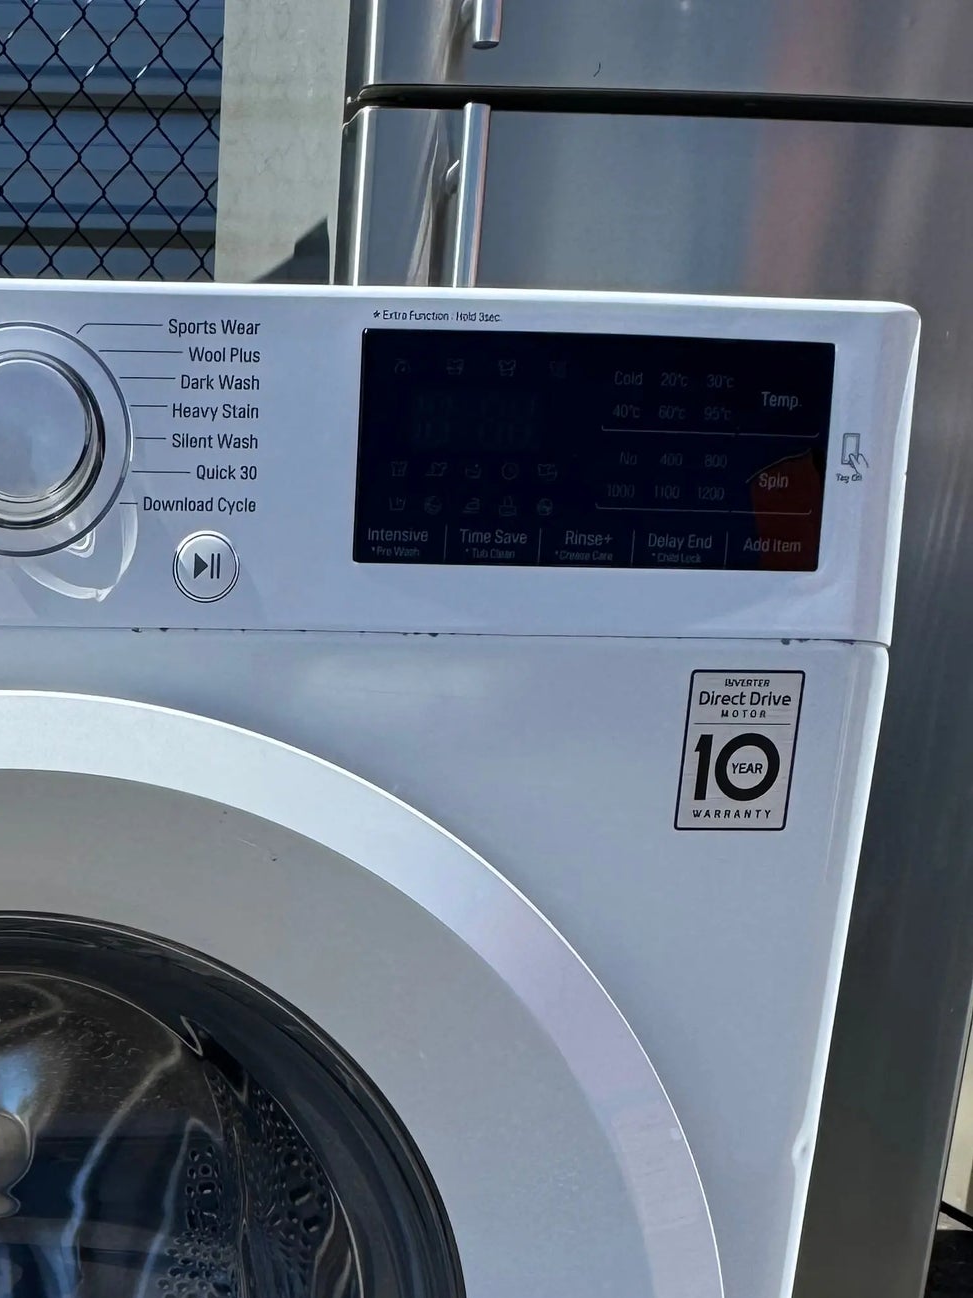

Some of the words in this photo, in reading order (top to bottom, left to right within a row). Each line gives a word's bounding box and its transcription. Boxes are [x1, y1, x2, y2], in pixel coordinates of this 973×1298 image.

[409, 310, 449, 321] Function
[456, 312, 476, 321] Hold
[168, 318, 217, 338] Sports
[221, 319, 261, 335] Wear
[189, 347, 226, 363] Wool
[230, 348, 261, 363] Plus
[181, 374, 214, 390] Dark
[219, 375, 260, 391] Wash
[614, 370, 643, 386] Cold
[761, 391, 802, 412] Temp.
[172, 403, 218, 422] Heavy
[222, 404, 259, 419] Stain
[172, 433, 213, 449] Silent
[217, 434, 258, 449] Wash
[659, 452, 683, 467] 400
[196, 464, 236, 481] Quick
[240, 465, 257, 480] 30
[758, 472, 789, 490] Spin
[606, 484, 635, 498] 1000
[654, 485, 680, 499] 1100
[698, 486, 725, 501] 1200
[143, 496, 213, 512] Download
[217, 497, 256, 516] Cycle
[367, 528, 428, 542] Intensive
[460, 529, 491, 544] Time
[494, 530, 527, 545] Save
[565, 530, 613, 546] Rinse+
[648, 533, 684, 549] Delay
[688, 534, 713, 549] End
[393, 547, 420, 557] Wash
[743, 537, 770, 552] Add
[773, 538, 801, 553] Item
[724, 679, 770, 687] INVERTER
[698, 691, 746, 706] Direct
[749, 691, 792, 707] Drive
[721, 709, 766, 718] MOTOR
[694, 732, 780, 802] 10
[731, 762, 763, 774] YEAR
[692, 809, 772, 819] WARRANTY
